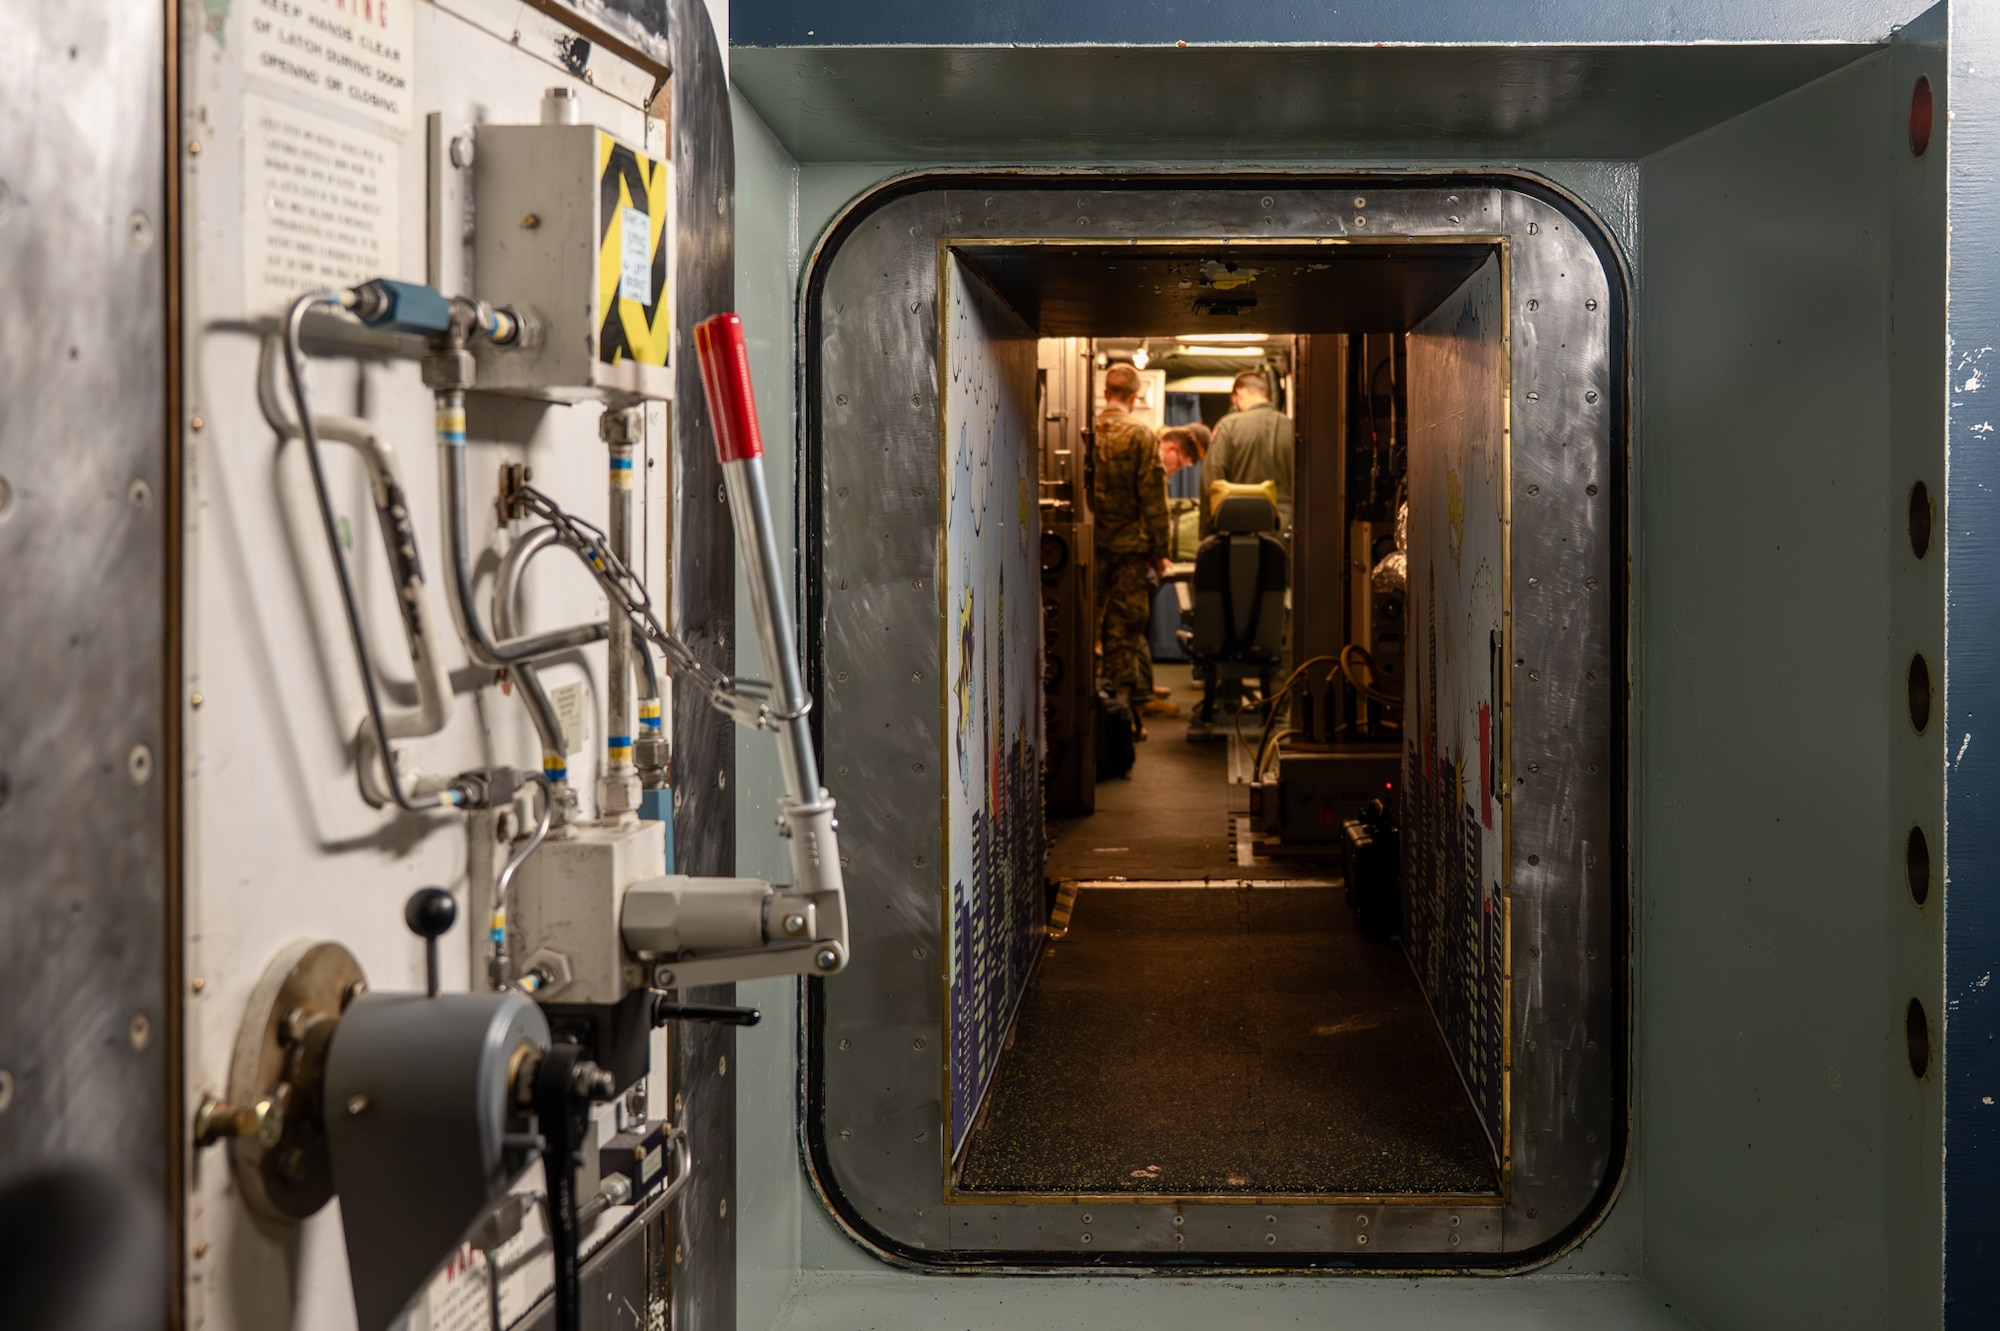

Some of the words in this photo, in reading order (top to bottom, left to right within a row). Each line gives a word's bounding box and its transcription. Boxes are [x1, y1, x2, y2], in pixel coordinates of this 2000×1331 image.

[278, 27, 323, 56] LATCH
[325, 47, 373, 77] DURING
[376, 67, 407, 90] DOOR
[308, 12, 353, 43] HANDS
[359, 34, 401, 62] CLEAR
[259, 51, 319, 84] OPENING
[326, 77, 343, 91] OR
[348, 84, 400, 114] CLOSING
